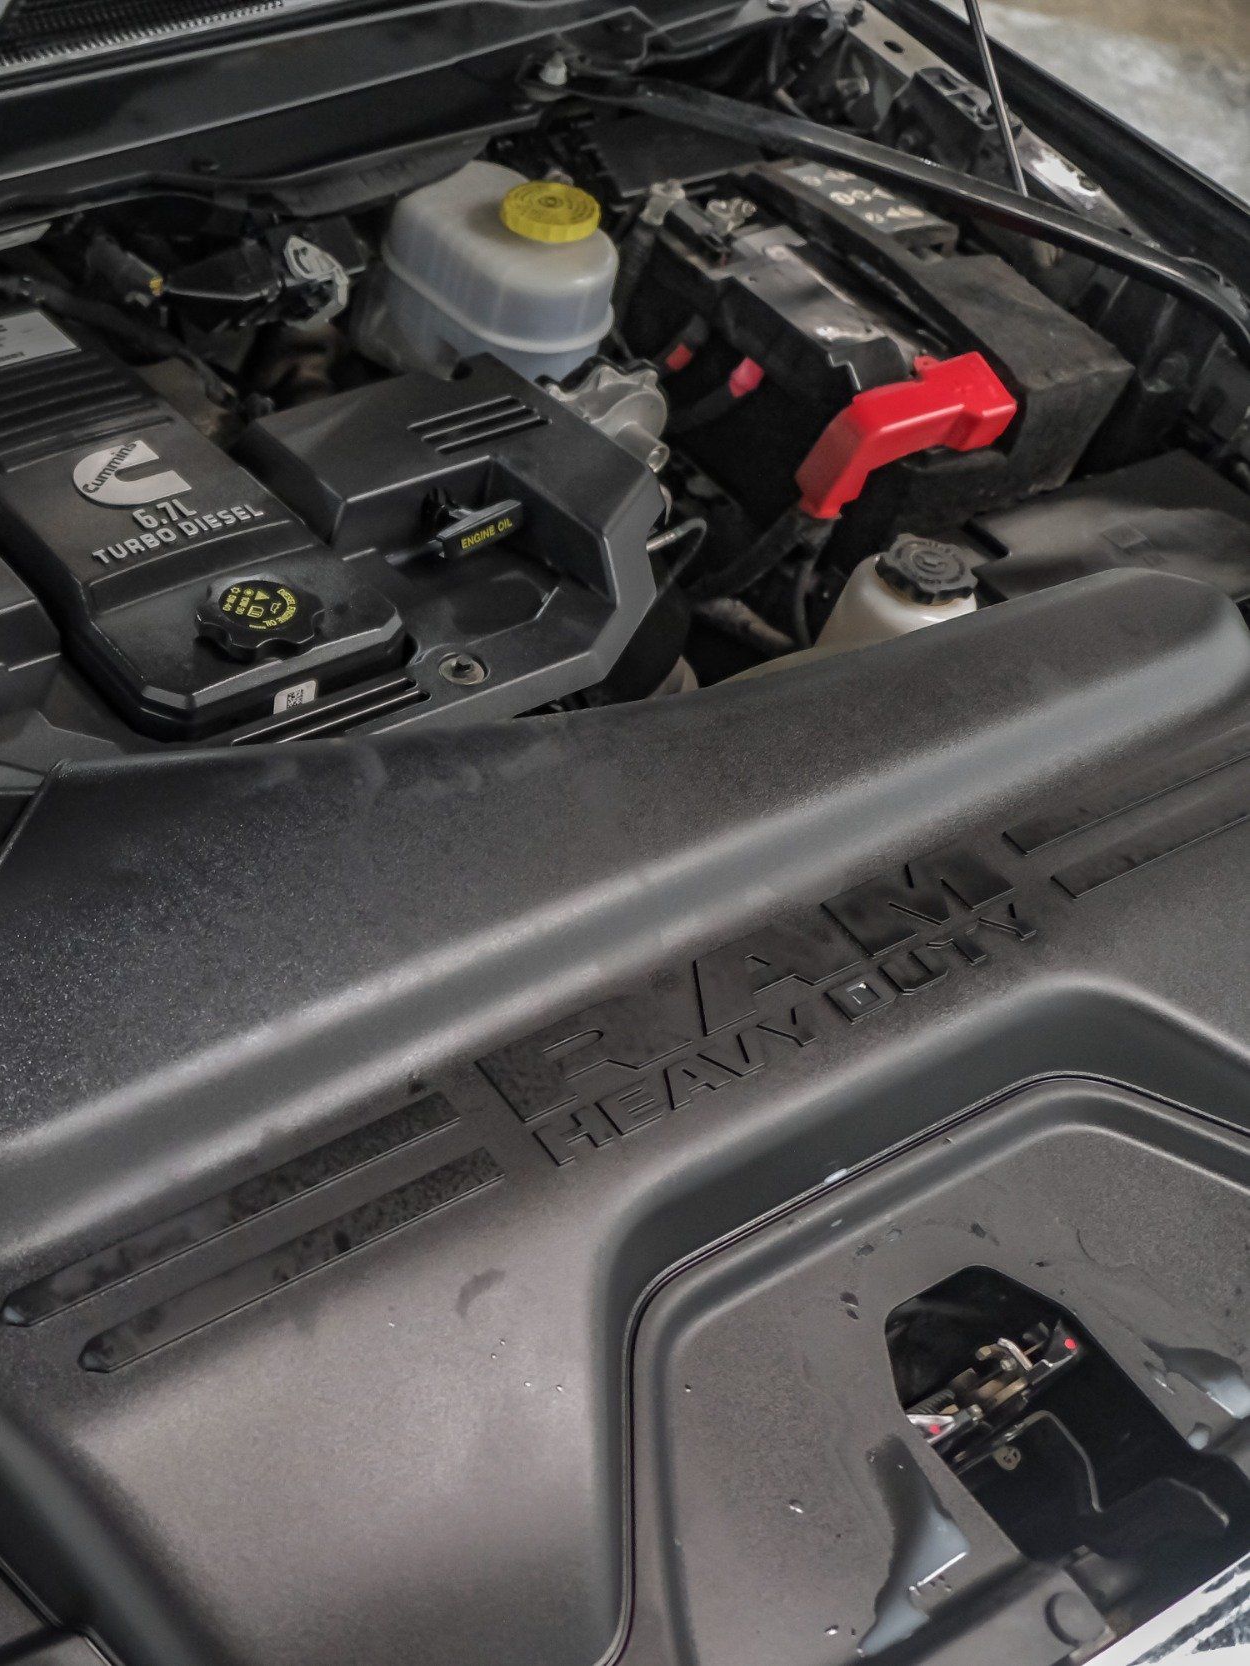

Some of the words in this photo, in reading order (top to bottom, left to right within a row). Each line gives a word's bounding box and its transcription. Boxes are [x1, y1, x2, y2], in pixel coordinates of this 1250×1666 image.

[82, 442, 137, 494] Cummins
[92, 527, 177, 564] TURBO
[178, 504, 264, 537] DIESEL
[132, 498, 197, 530] 6.7L
[461, 524, 496, 549] ENGINE
[498, 518, 513, 532] OIL
[475, 842, 1016, 1123] RAM
[532, 1000, 818, 1166] HEAVY
[825, 902, 1038, 1024] DUTY
